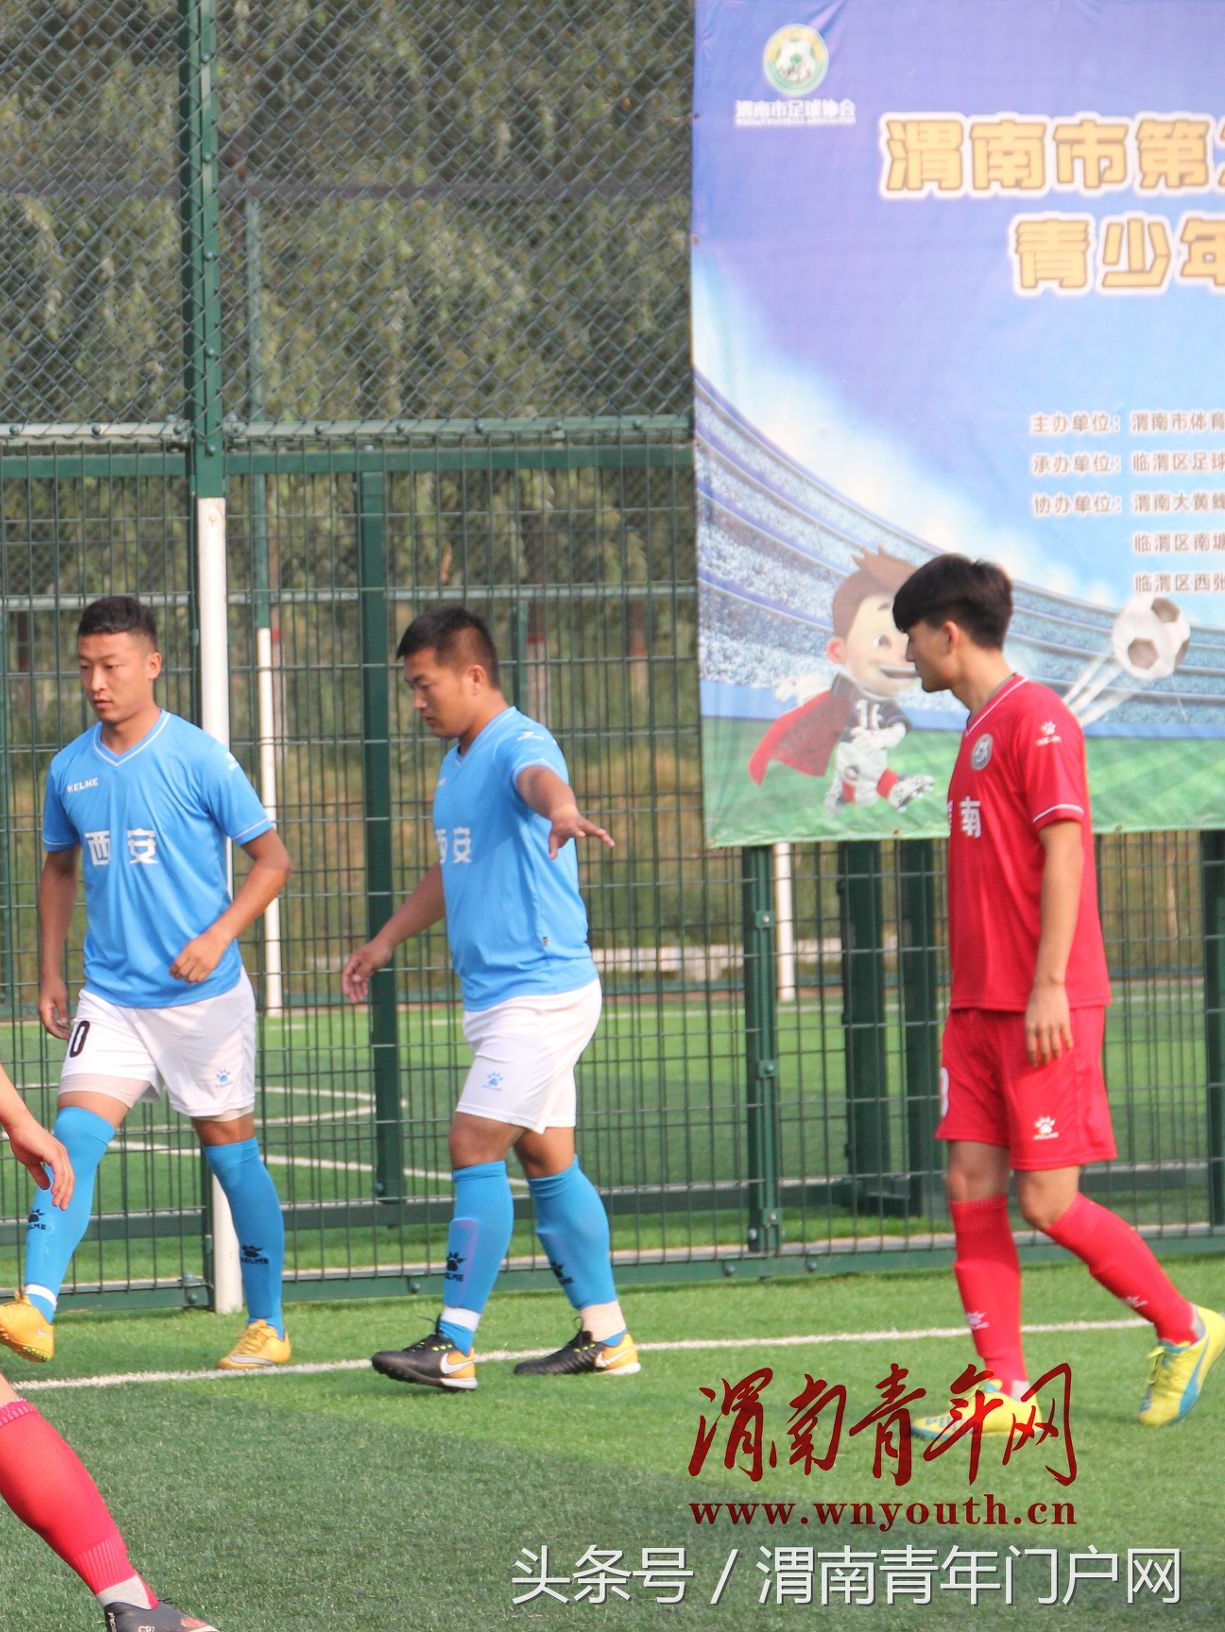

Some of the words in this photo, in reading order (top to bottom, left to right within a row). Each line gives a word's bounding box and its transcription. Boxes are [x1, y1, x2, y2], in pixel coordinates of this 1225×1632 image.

[883, 117, 1225, 193] 渭南市第
[85, 828, 158, 866] 西安
